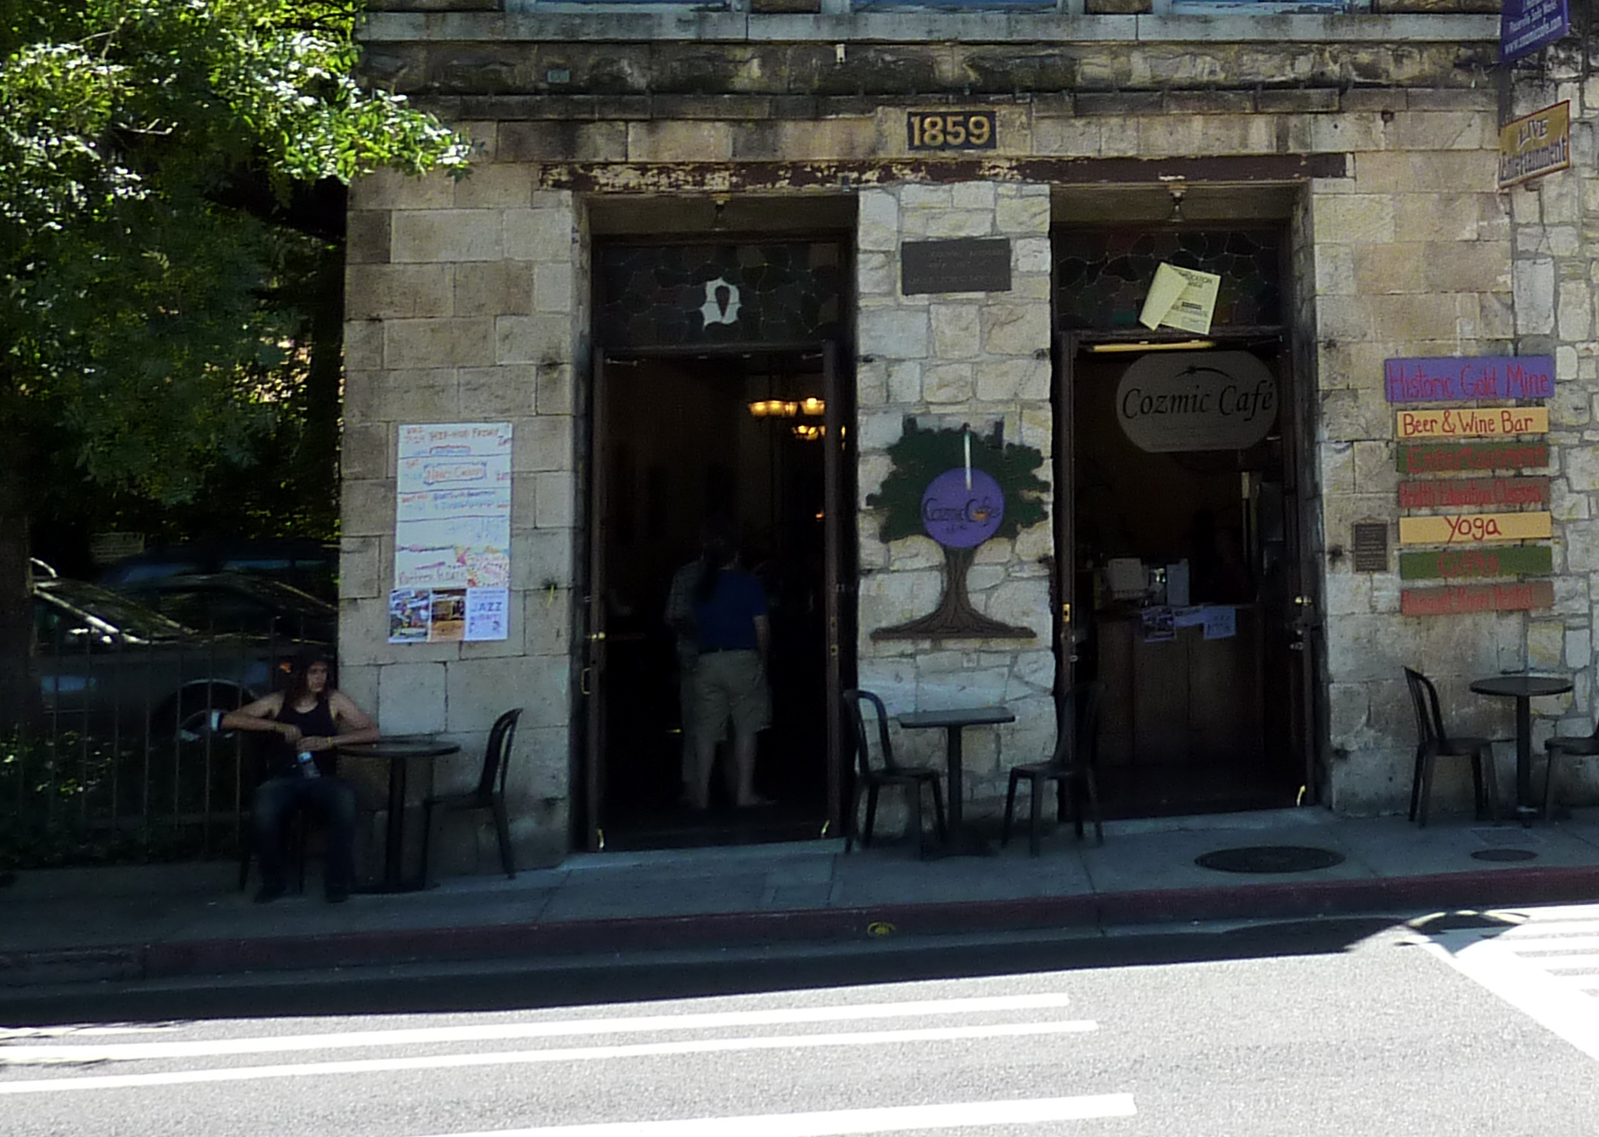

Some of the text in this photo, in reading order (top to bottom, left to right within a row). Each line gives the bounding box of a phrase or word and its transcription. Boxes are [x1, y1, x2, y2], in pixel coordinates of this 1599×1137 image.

[910, 115, 990, 147] 1859
[1517, 116, 1550, 152] LIVE
[1387, 363, 1550, 400] Historic Gold Mine
[1122, 379, 1274, 423] Cozmic Café
[1402, 409, 1534, 436] Beer & Wine Bar
[1443, 514, 1501, 544] Yoga
[470, 601, 503, 612] JAZZ
